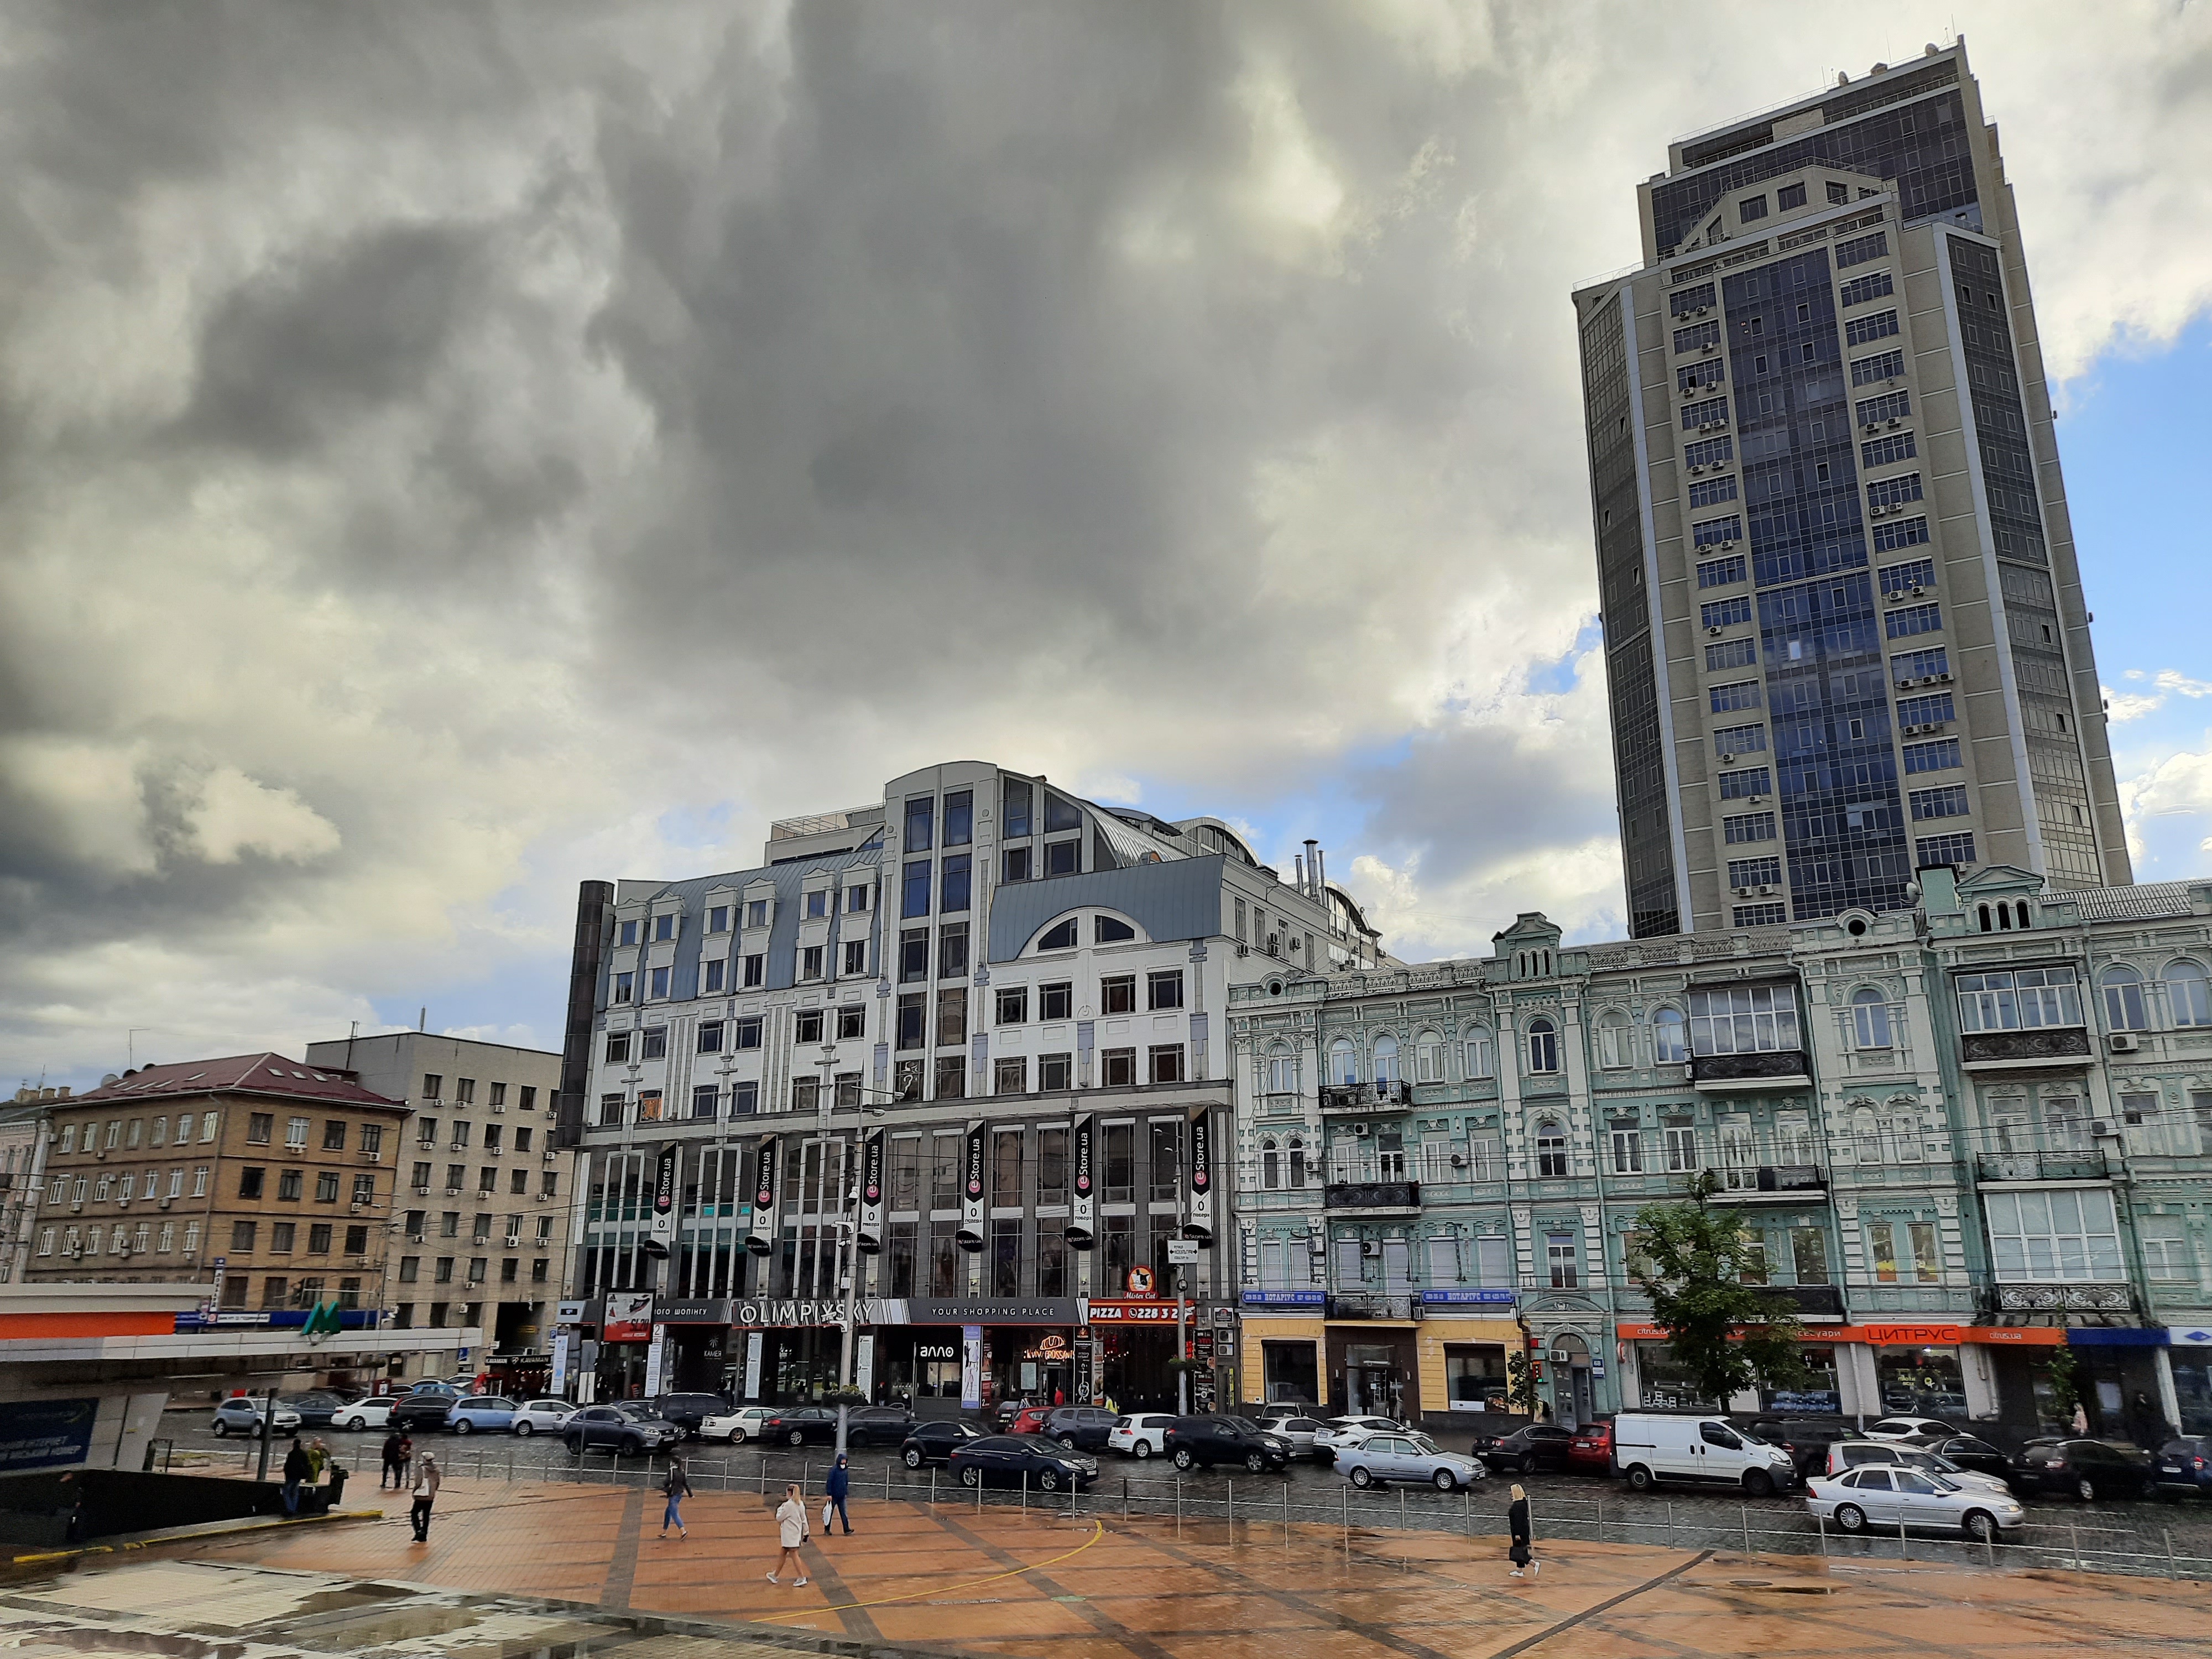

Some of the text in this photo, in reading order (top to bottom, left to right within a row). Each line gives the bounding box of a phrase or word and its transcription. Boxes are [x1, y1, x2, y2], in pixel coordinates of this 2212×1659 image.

[759, 1152, 771, 1200] eStore.ua
[868, 1145, 879, 1194] eStore.ua
[970, 1139, 980, 1190] eStore.ua
[1079, 1133, 1088, 1185] eStore.ua
[1196, 1126, 1204, 1181] eStore.ua
[659, 1158, 671, 1204] eStore.ua
[1089, 1307, 1122, 1318] PIZZA
[1137, 1307, 1159, 1318] 228
[1161, 1307, 1168, 1318] 3
[1868, 1328, 1957, 1342] ЦИТРУС
